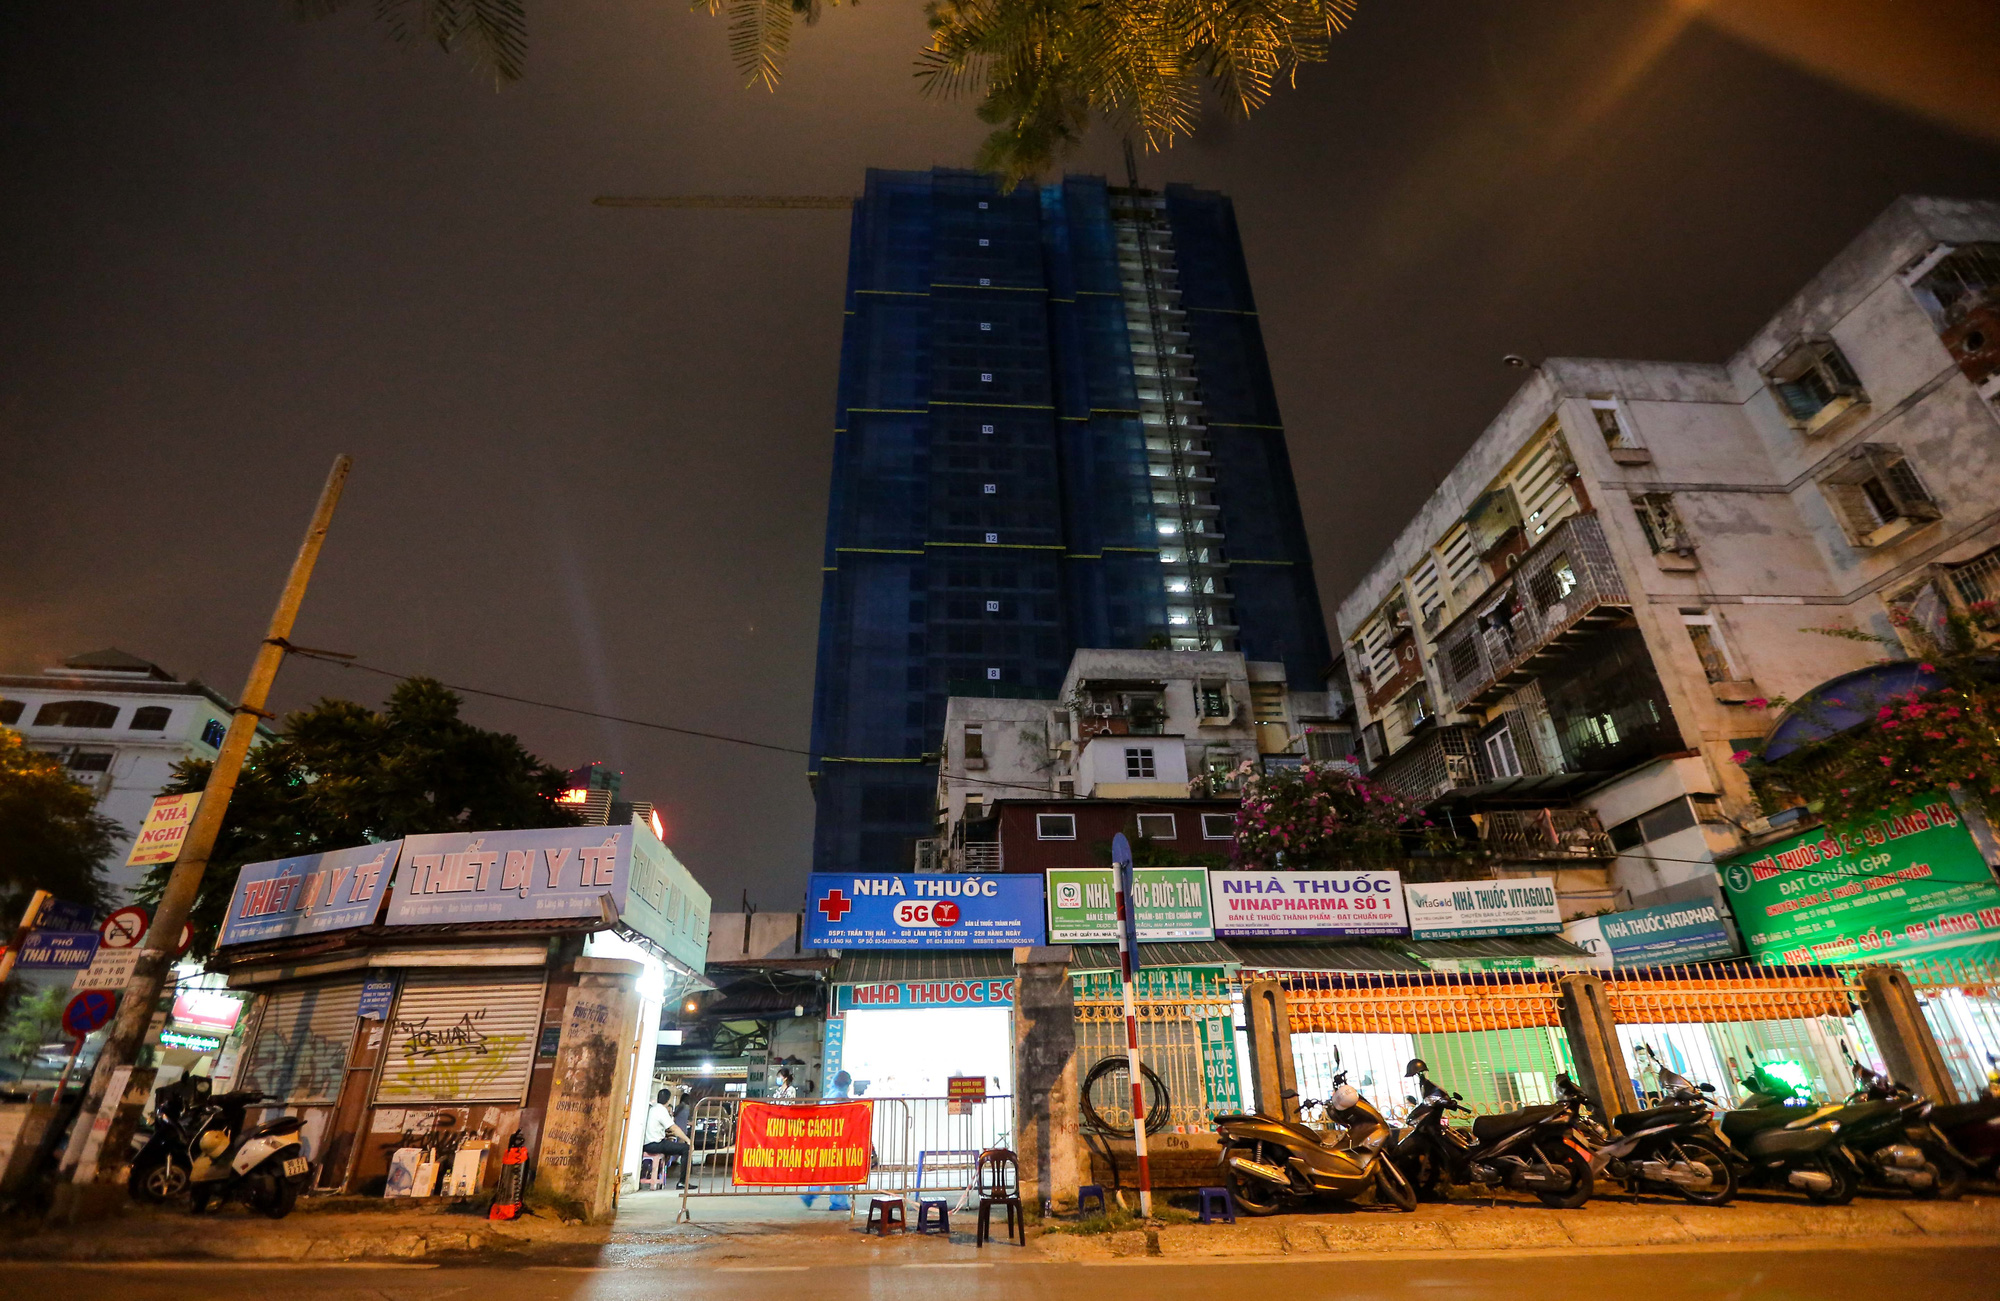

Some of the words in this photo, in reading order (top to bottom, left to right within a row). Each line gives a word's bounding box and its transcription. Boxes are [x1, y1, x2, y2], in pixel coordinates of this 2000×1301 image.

[1751, 854, 1780, 882] NHÀ
[1776, 840, 1822, 873] THUỐC
[1841, 833, 1856, 855] 2
[1925, 802, 1959, 829] HẠ
[410, 838, 498, 895] THIẾT
[500, 849, 537, 898] BỊ
[544, 848, 572, 888] Y
[579, 832, 622, 887] TẾ
[1779, 877, 1807, 896] ĐẠT
[1808, 861, 1859, 887] CHUẨN
[1860, 853, 1892, 873] GPP
[239, 863, 302, 918] THIẾT
[295, 870, 327, 918] BỊ
[325, 866, 352, 906] Y
[348, 847, 391, 903] TẾ
[853, 876, 907, 896] NHÀ
[914, 876, 998, 897] THUỐC
[1085, 878, 1111, 908] NHÀ
[1151, 876, 1176, 908] ĐỨC
[1176, 878, 1203, 907] TÂM
[1223, 877, 1285, 894] NHÀ
[1293, 874, 1391, 893] THUỐC
[1765, 899, 1799, 917] CHUYÊN
[1820, 887, 1833, 904] LẺ
[1831, 881, 1863, 900] THUỐC
[1863, 874, 1898, 893] THÀNH
[1898, 862, 1933, 882] PHẨM
[1229, 898, 1348, 911] VINAPHARMA
[1354, 894, 1376, 910] SỐ
[1383, 898, 1391, 910] 1
[1415, 899, 1452, 908] VitaGold
[1452, 887, 1475, 911] NHÀ
[1475, 883, 1506, 910] THUỐC
[1508, 887, 1554, 908] VITAGOLD
[900, 905, 929, 923] 5G
[1193, 911, 1203, 919] GPP
[1229, 913, 1244, 921] BÁN
[1245, 912, 1255, 921] LẺ
[1257, 913, 1282, 921] THUỐC
[1283, 913, 1308, 921] THÀNH
[1309, 911, 1330, 921] PHẨM
[1337, 913, 1351, 921] ĐẠT
[1353, 911, 1378, 921] CHUẨN
[1605, 918, 1629, 939] NHÀ
[1627, 912, 1664, 935] THUỐC
[1661, 905, 1720, 930] HATAPHAR
[51, 936, 76, 947] PHỐ
[913, 929, 927, 937] LÀM
[928, 929, 942, 938] VIỆC
[1751, 932, 1768, 946] 95
[1782, 943, 1814, 966] NHÀ
[1810, 933, 1858, 962] THUỐC
[1858, 926, 1881, 952] SỐ
[1881, 929, 1897, 948] 2
[1905, 923, 1930, 942] 95
[1926, 913, 1980, 938] LÁNG
[22, 945, 53, 962] THÁI
[53, 948, 91, 965] THỊNH
[1206, 1061, 1233, 1078] ĐỨC
[1208, 1080, 1236, 1096] TÂM
[766, 1117, 786, 1137] KHU
[788, 1117, 805, 1142] VỰC
[807, 1115, 832, 1138] CÁCH
[834, 1118, 845, 1137] LY
[742, 1143, 775, 1168] KHÔNG
[776, 1145, 802, 1172] PHẬN
[804, 1146, 819, 1172] SỰ
[819, 1142, 843, 1168] MIỄN
[845, 1144, 864, 1167] VÀO
